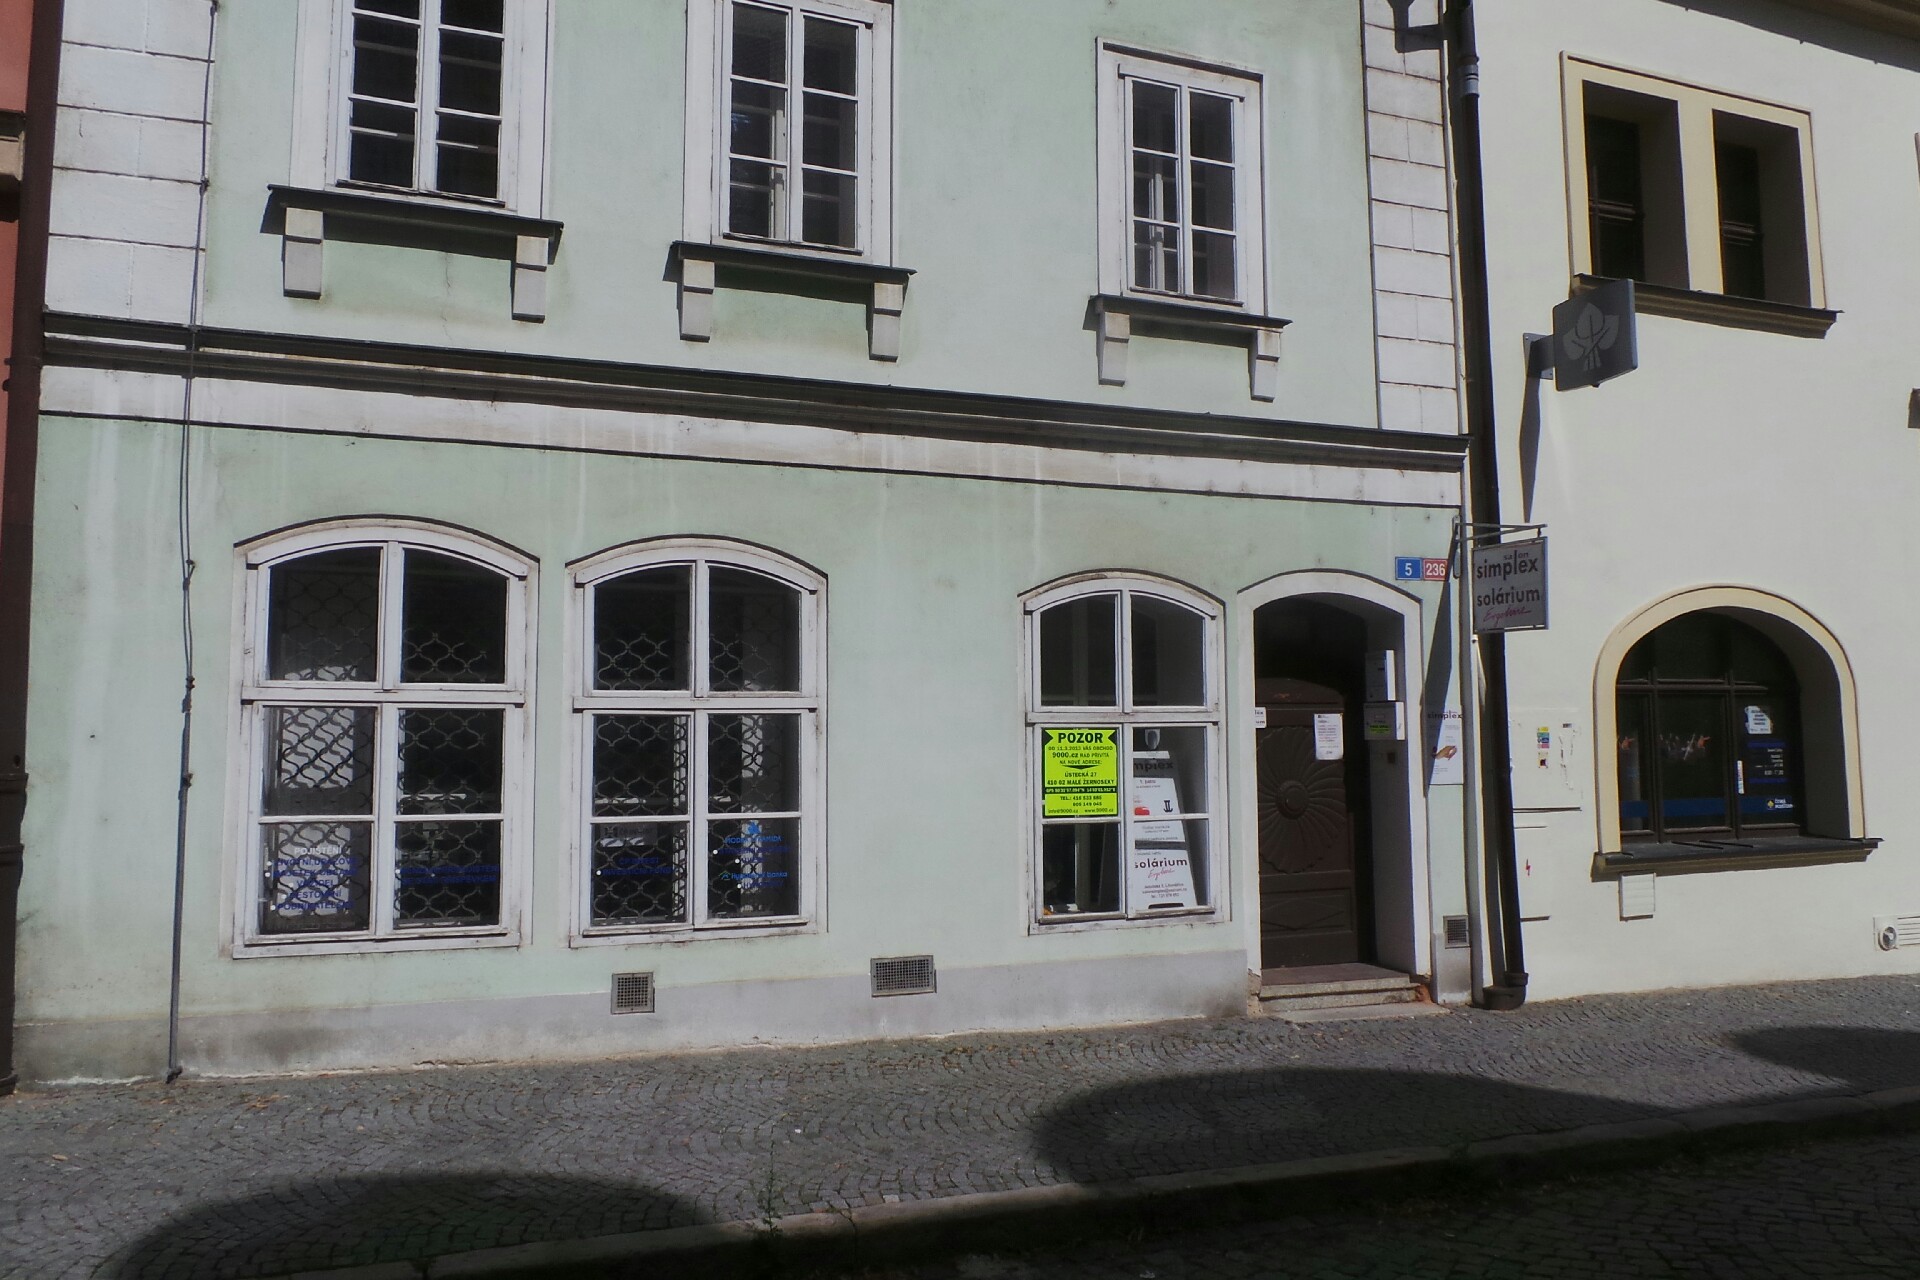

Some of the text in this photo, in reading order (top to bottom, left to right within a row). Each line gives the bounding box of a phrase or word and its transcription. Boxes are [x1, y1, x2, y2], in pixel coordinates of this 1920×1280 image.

[1404, 562, 1413, 576] 5
[1426, 563, 1446, 576] 236
[1476, 551, 1539, 580] simplex
[1476, 586, 1540, 607] solárium
[1058, 732, 1103, 743] POZOR
[294, 845, 342, 854] POJIŠTĚNÍ
